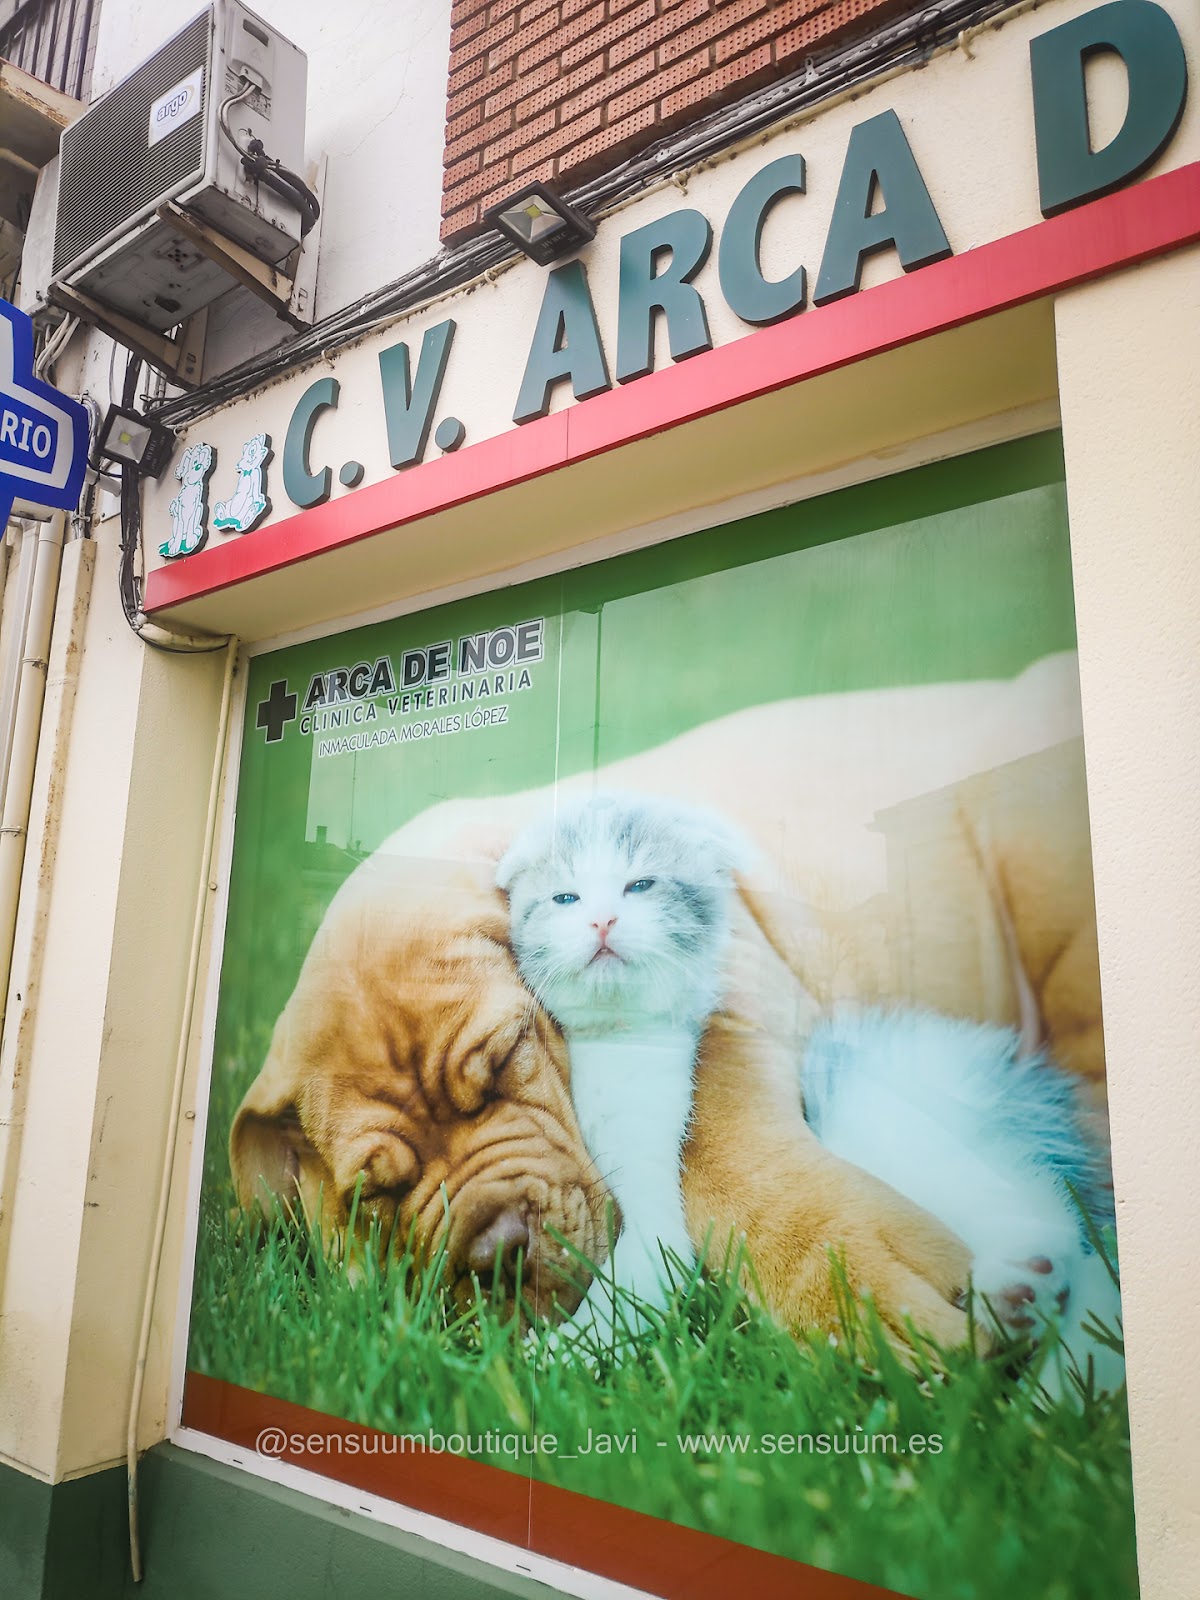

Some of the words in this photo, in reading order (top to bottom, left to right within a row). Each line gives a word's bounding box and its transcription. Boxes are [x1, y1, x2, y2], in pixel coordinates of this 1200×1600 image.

[156, 90, 188, 122] argo
[283, 319, 465, 509] C.V.
[512, 109, 952, 425] ARCA
[1030, 0, 1188, 219] D
[1, 410, 52, 459] RIO
[301, 656, 395, 712] ARCA
[400, 640, 451, 691] DE
[458, 618, 544, 677] NOE
[300, 702, 377, 735] CLINICA
[388, 669, 532, 713] VETERINARIA
[318, 727, 397, 758] INMACULADA
[400, 713, 461, 742] MORALES
[465, 704, 509, 728] LÓPEZ
